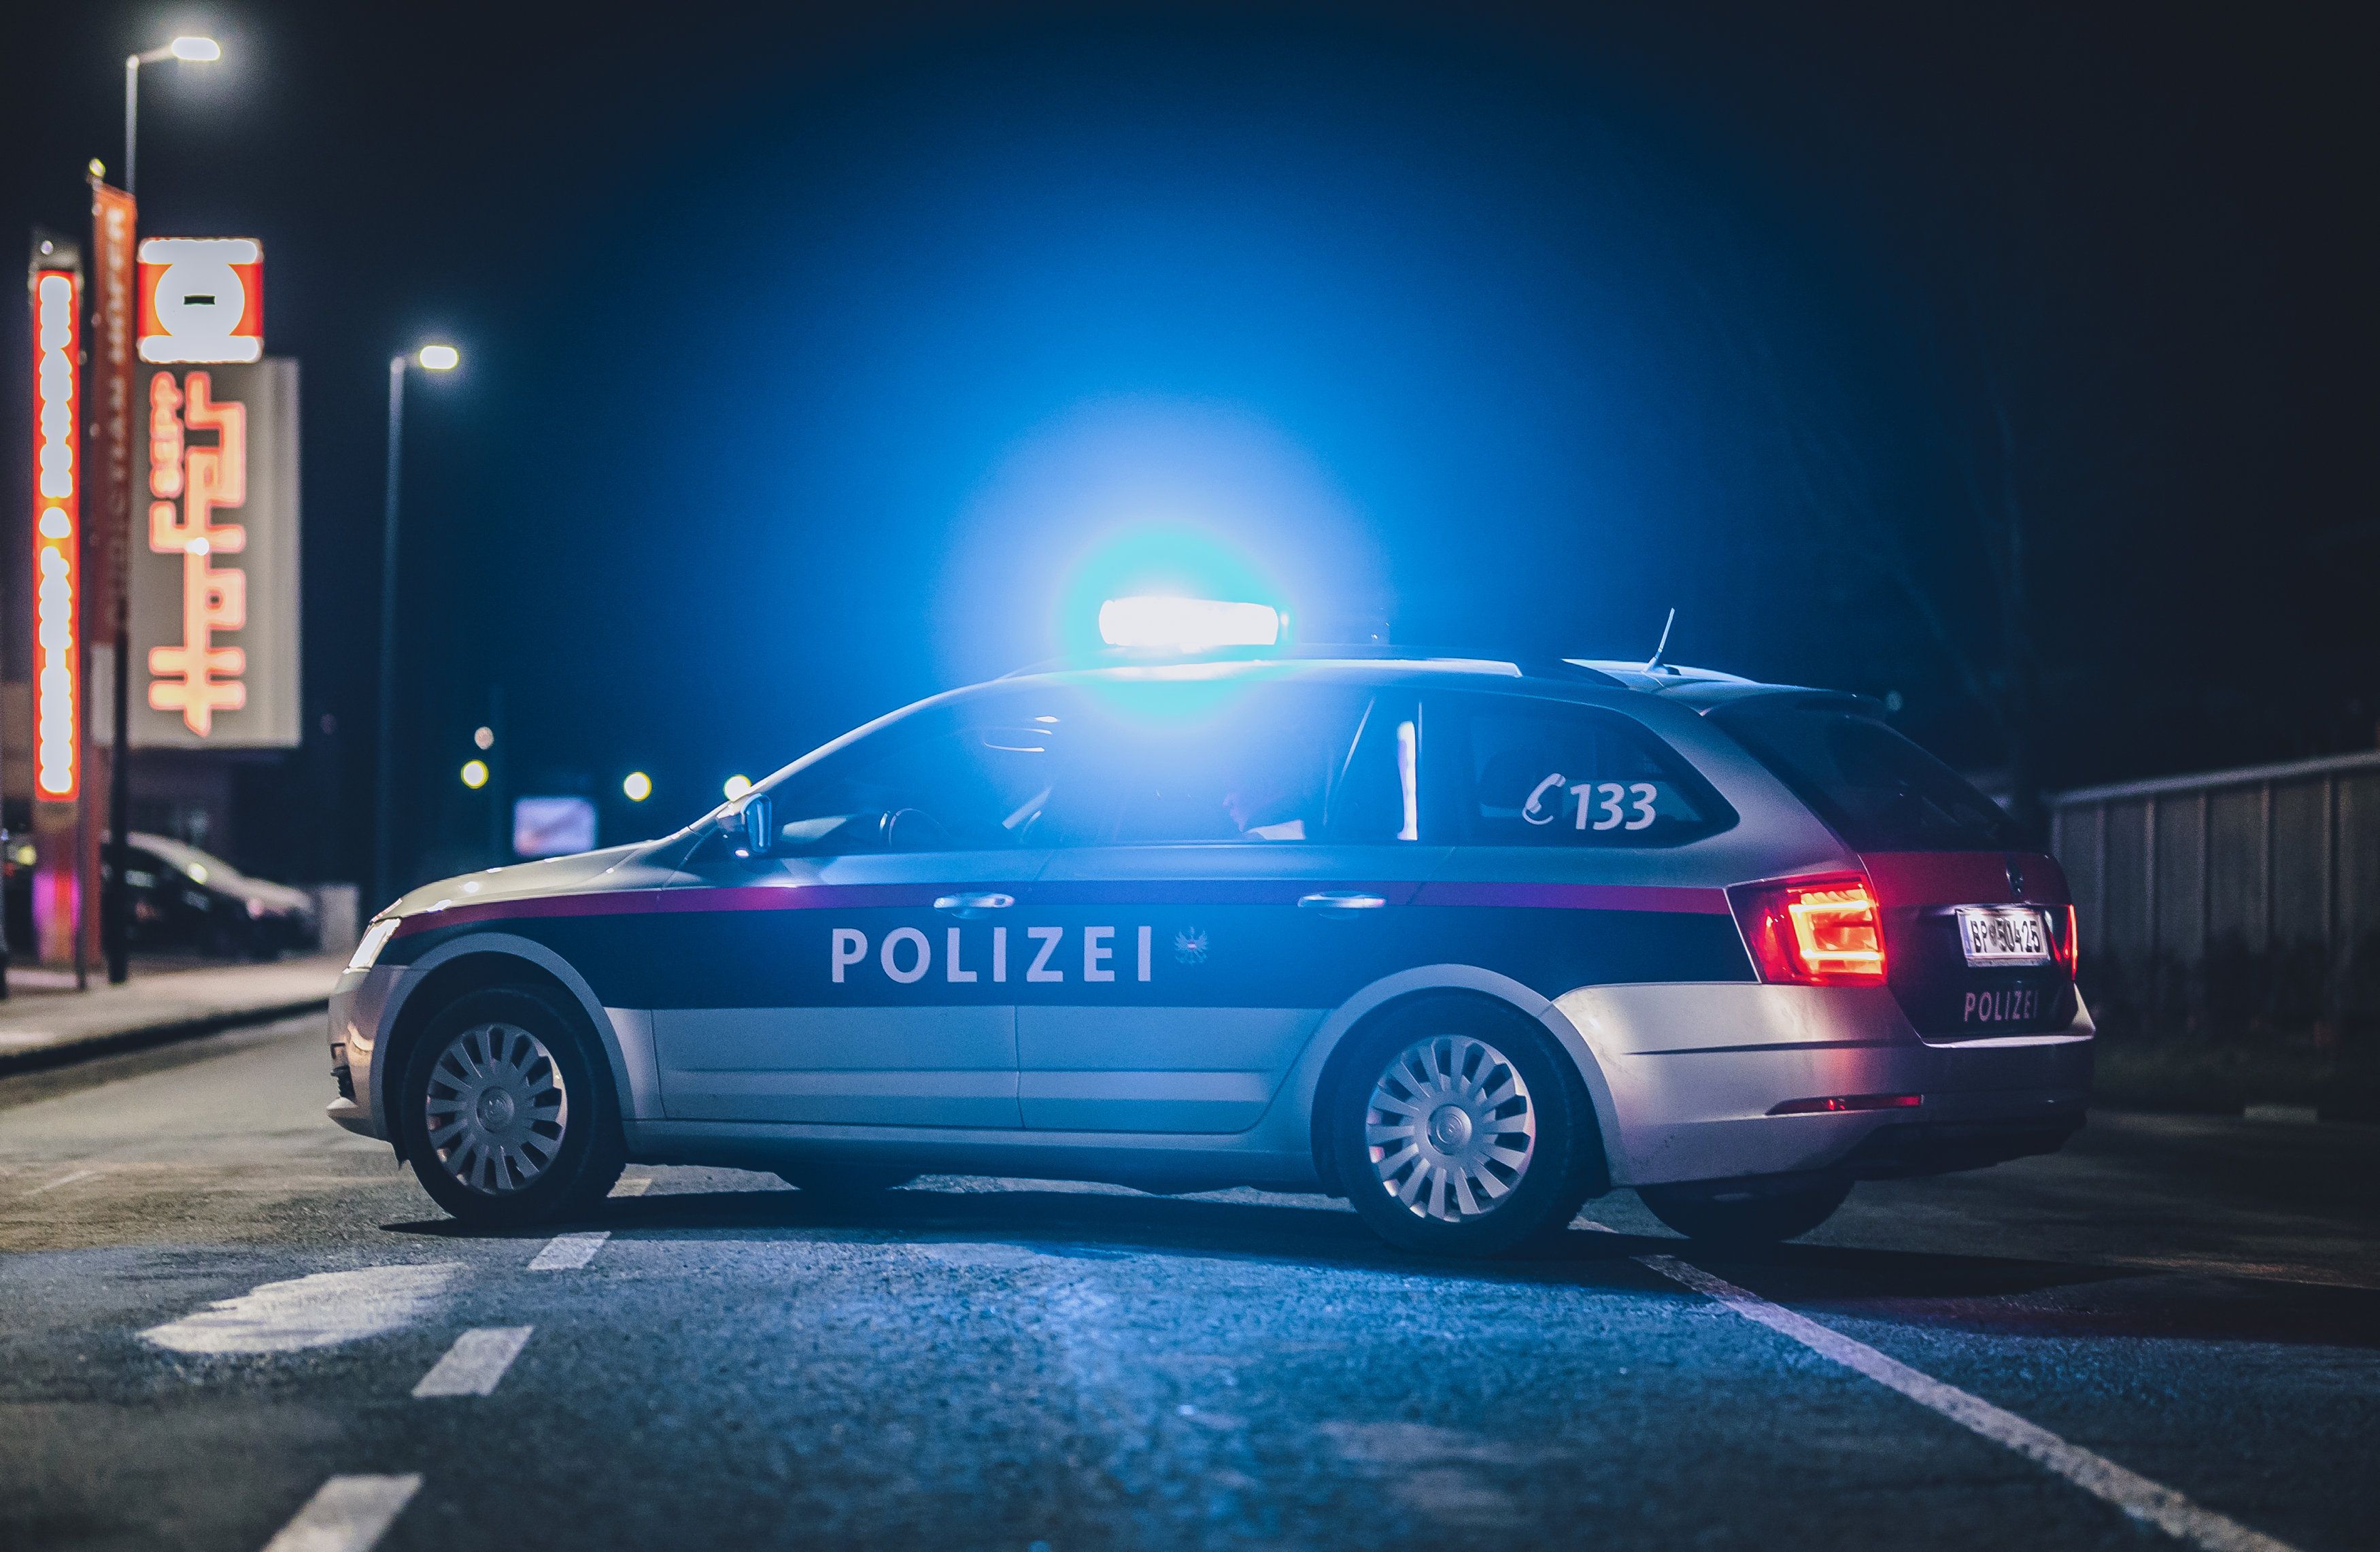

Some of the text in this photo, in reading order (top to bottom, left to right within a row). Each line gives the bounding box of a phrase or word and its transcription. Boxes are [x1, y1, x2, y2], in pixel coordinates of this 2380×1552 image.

[1570, 783, 1657, 830] 133
[832, 926, 1152, 983] POLIZEI
[1965, 990, 2039, 1022] POLIZEI
